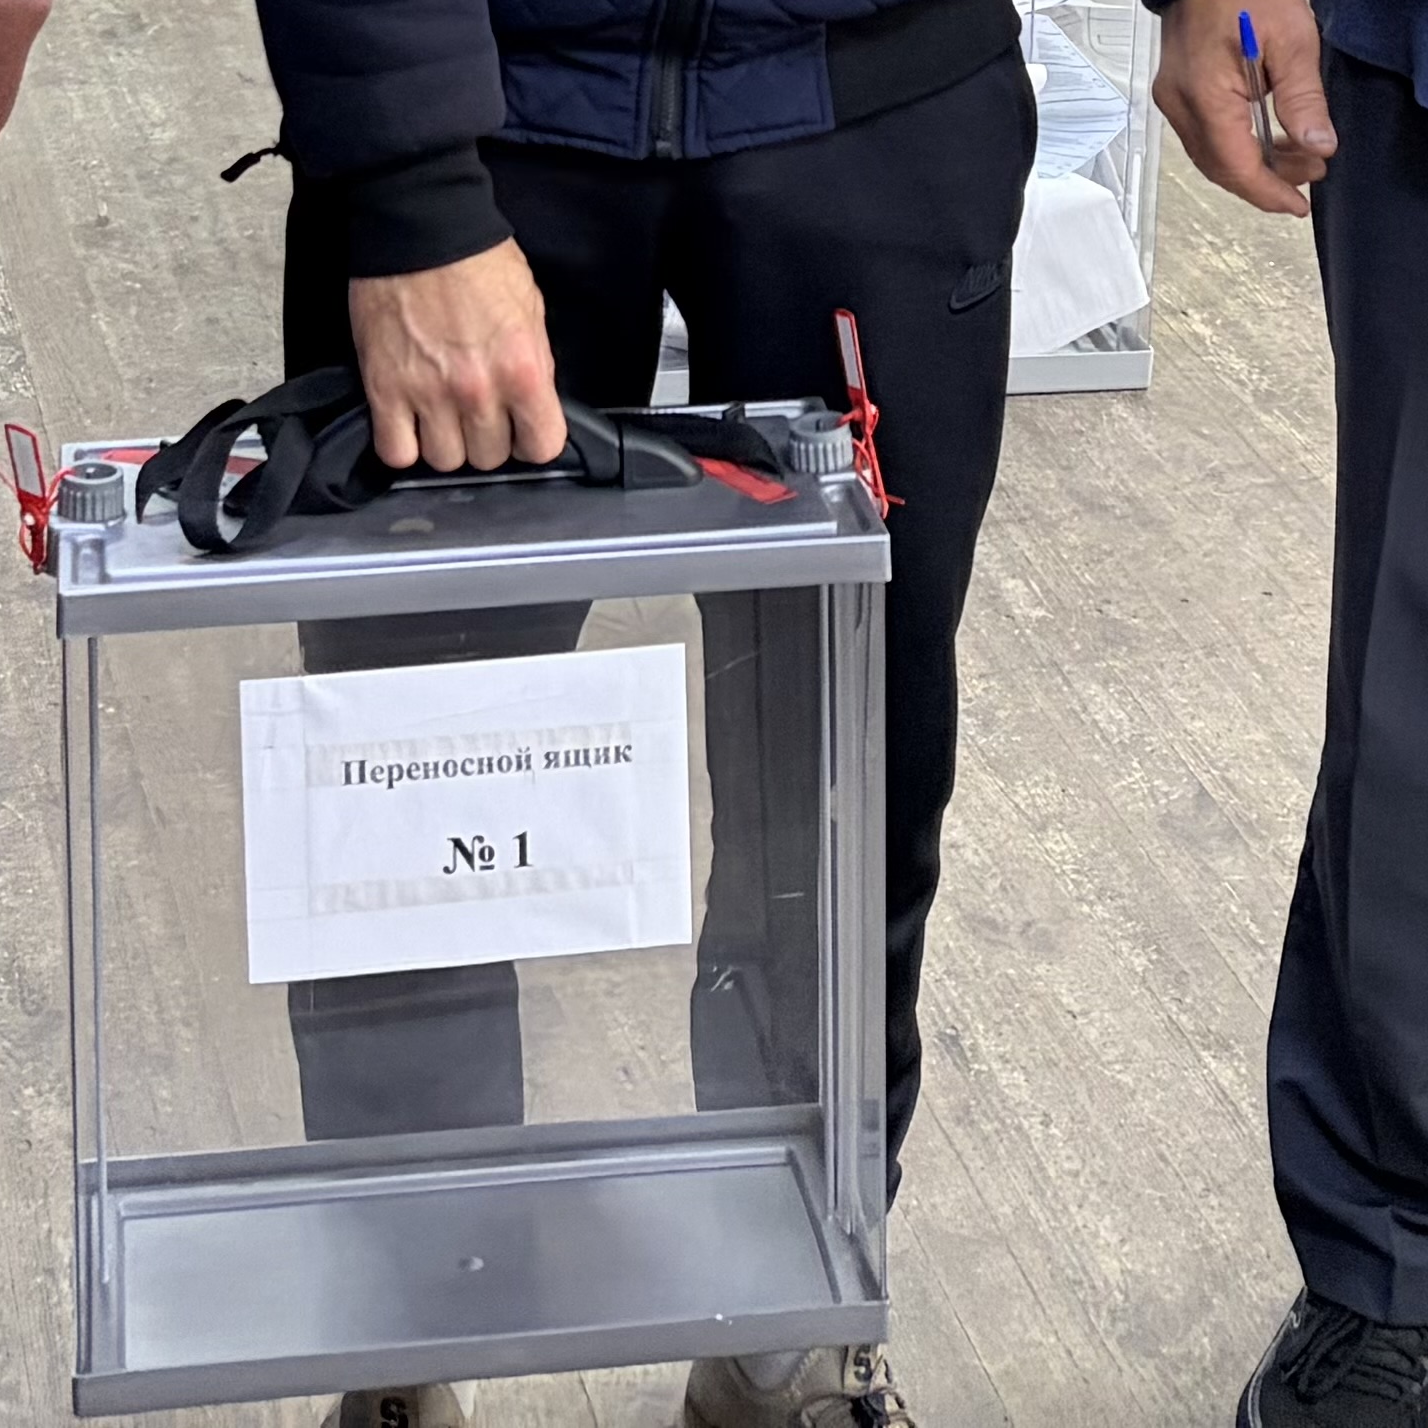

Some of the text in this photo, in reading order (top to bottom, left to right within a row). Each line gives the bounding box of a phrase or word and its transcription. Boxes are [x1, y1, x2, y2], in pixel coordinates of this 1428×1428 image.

[340, 740, 634, 790] Переносной ящик
[442, 831, 534, 875] № 1
